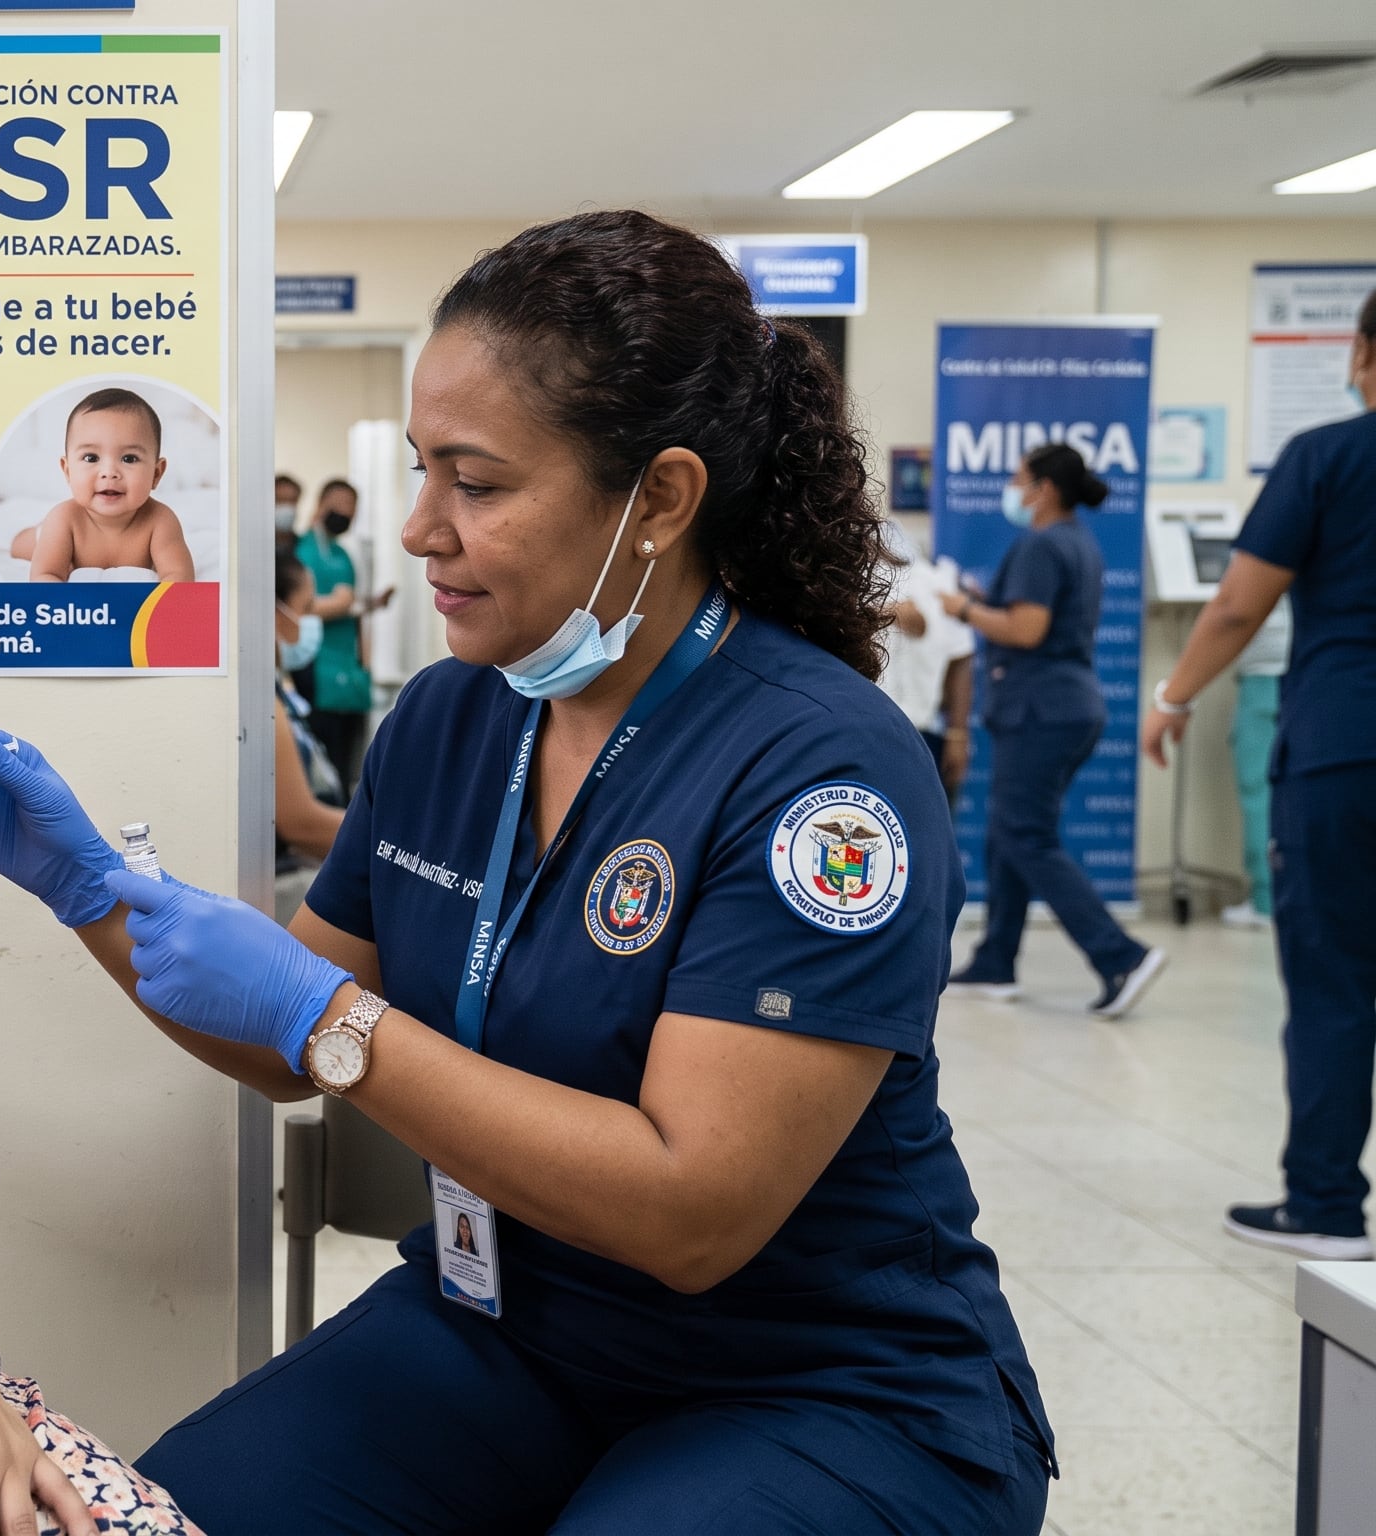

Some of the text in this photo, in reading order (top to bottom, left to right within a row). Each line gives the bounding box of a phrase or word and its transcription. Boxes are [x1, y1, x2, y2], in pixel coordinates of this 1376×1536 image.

[68, 84, 179, 106] CONTRA
[34, 299, 53, 320] a
[65, 295, 98, 320] tu
[111, 290, 197, 320] bebé
[16, 328, 58, 356] de
[70, 334, 171, 356] nacer.
[35, 602, 116, 626] Salud.
[596, 726, 640, 778] MINSA
[853, 791, 871, 806] DE
